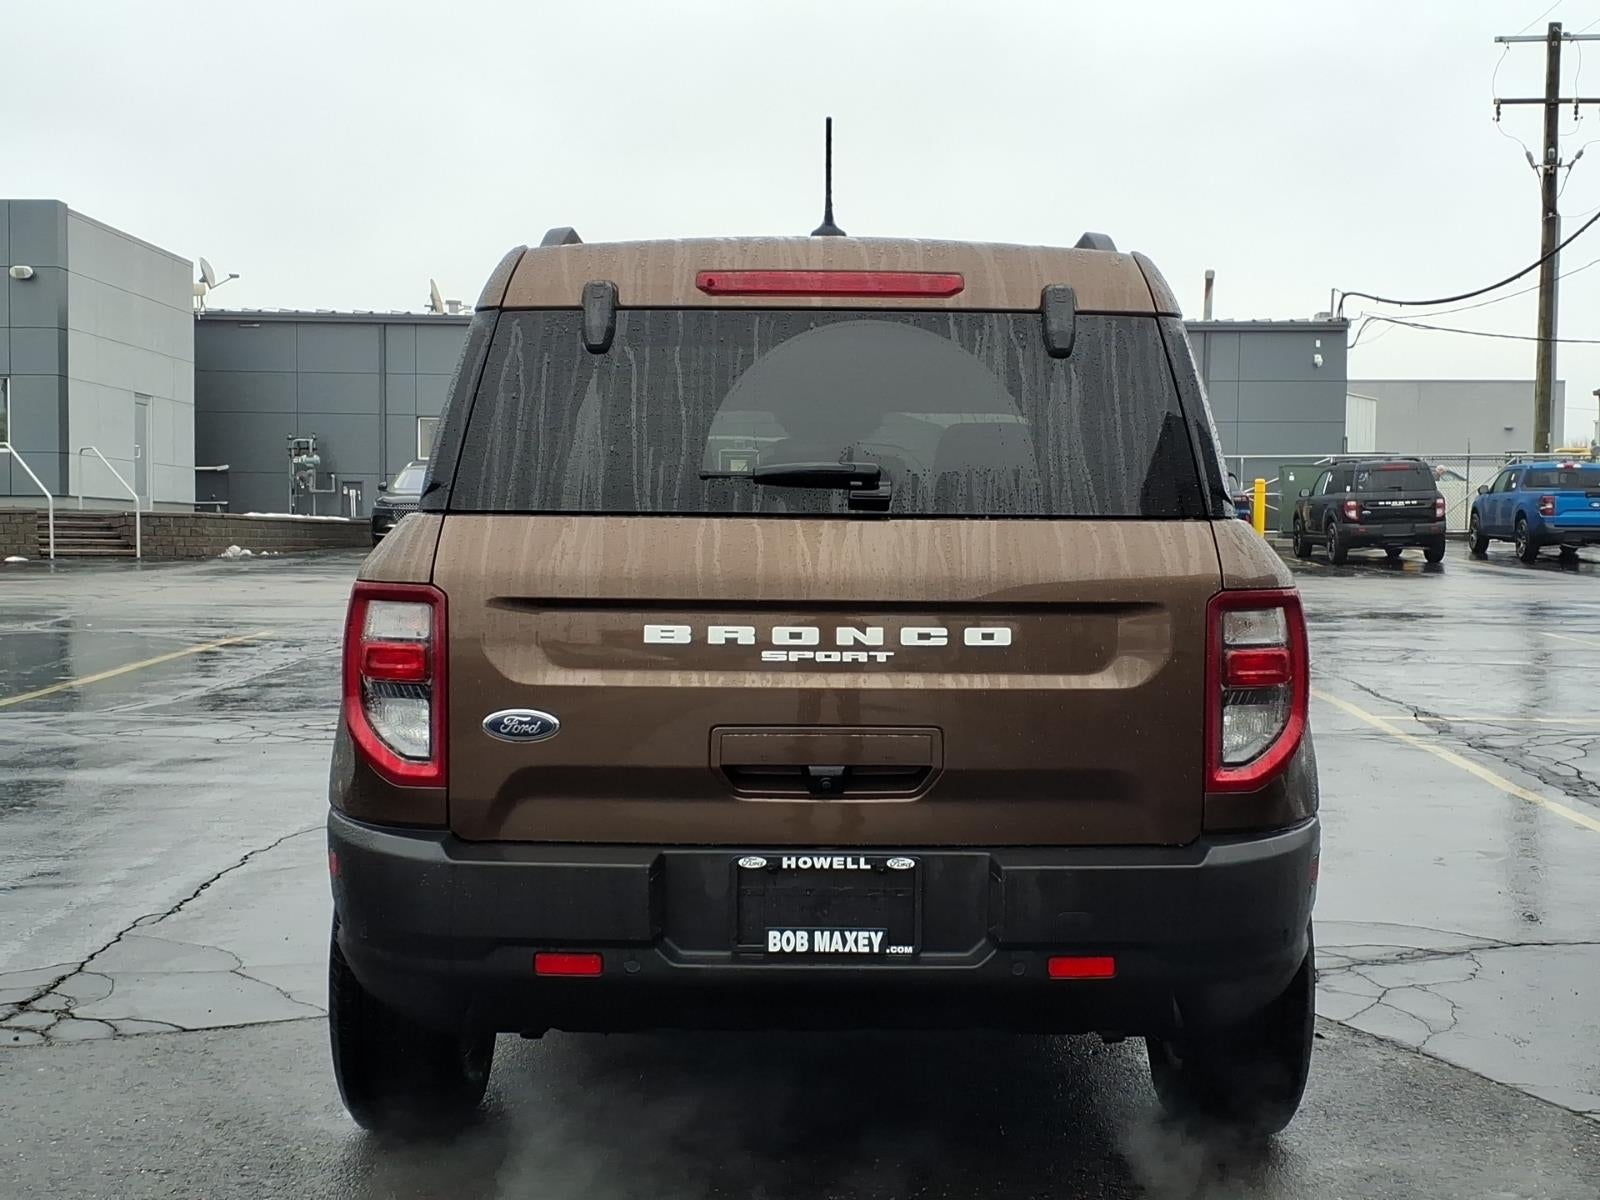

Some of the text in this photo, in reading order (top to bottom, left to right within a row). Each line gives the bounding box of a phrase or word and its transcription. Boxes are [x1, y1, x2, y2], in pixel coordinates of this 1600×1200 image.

[643, 624, 1012, 646] BRONCO
[761, 650, 894, 662] SPORT
[499, 716, 541, 734] Ford
[782, 857, 871, 869] HOWELL
[768, 930, 809, 953] BOB
[814, 930, 883, 953] MAXEY
